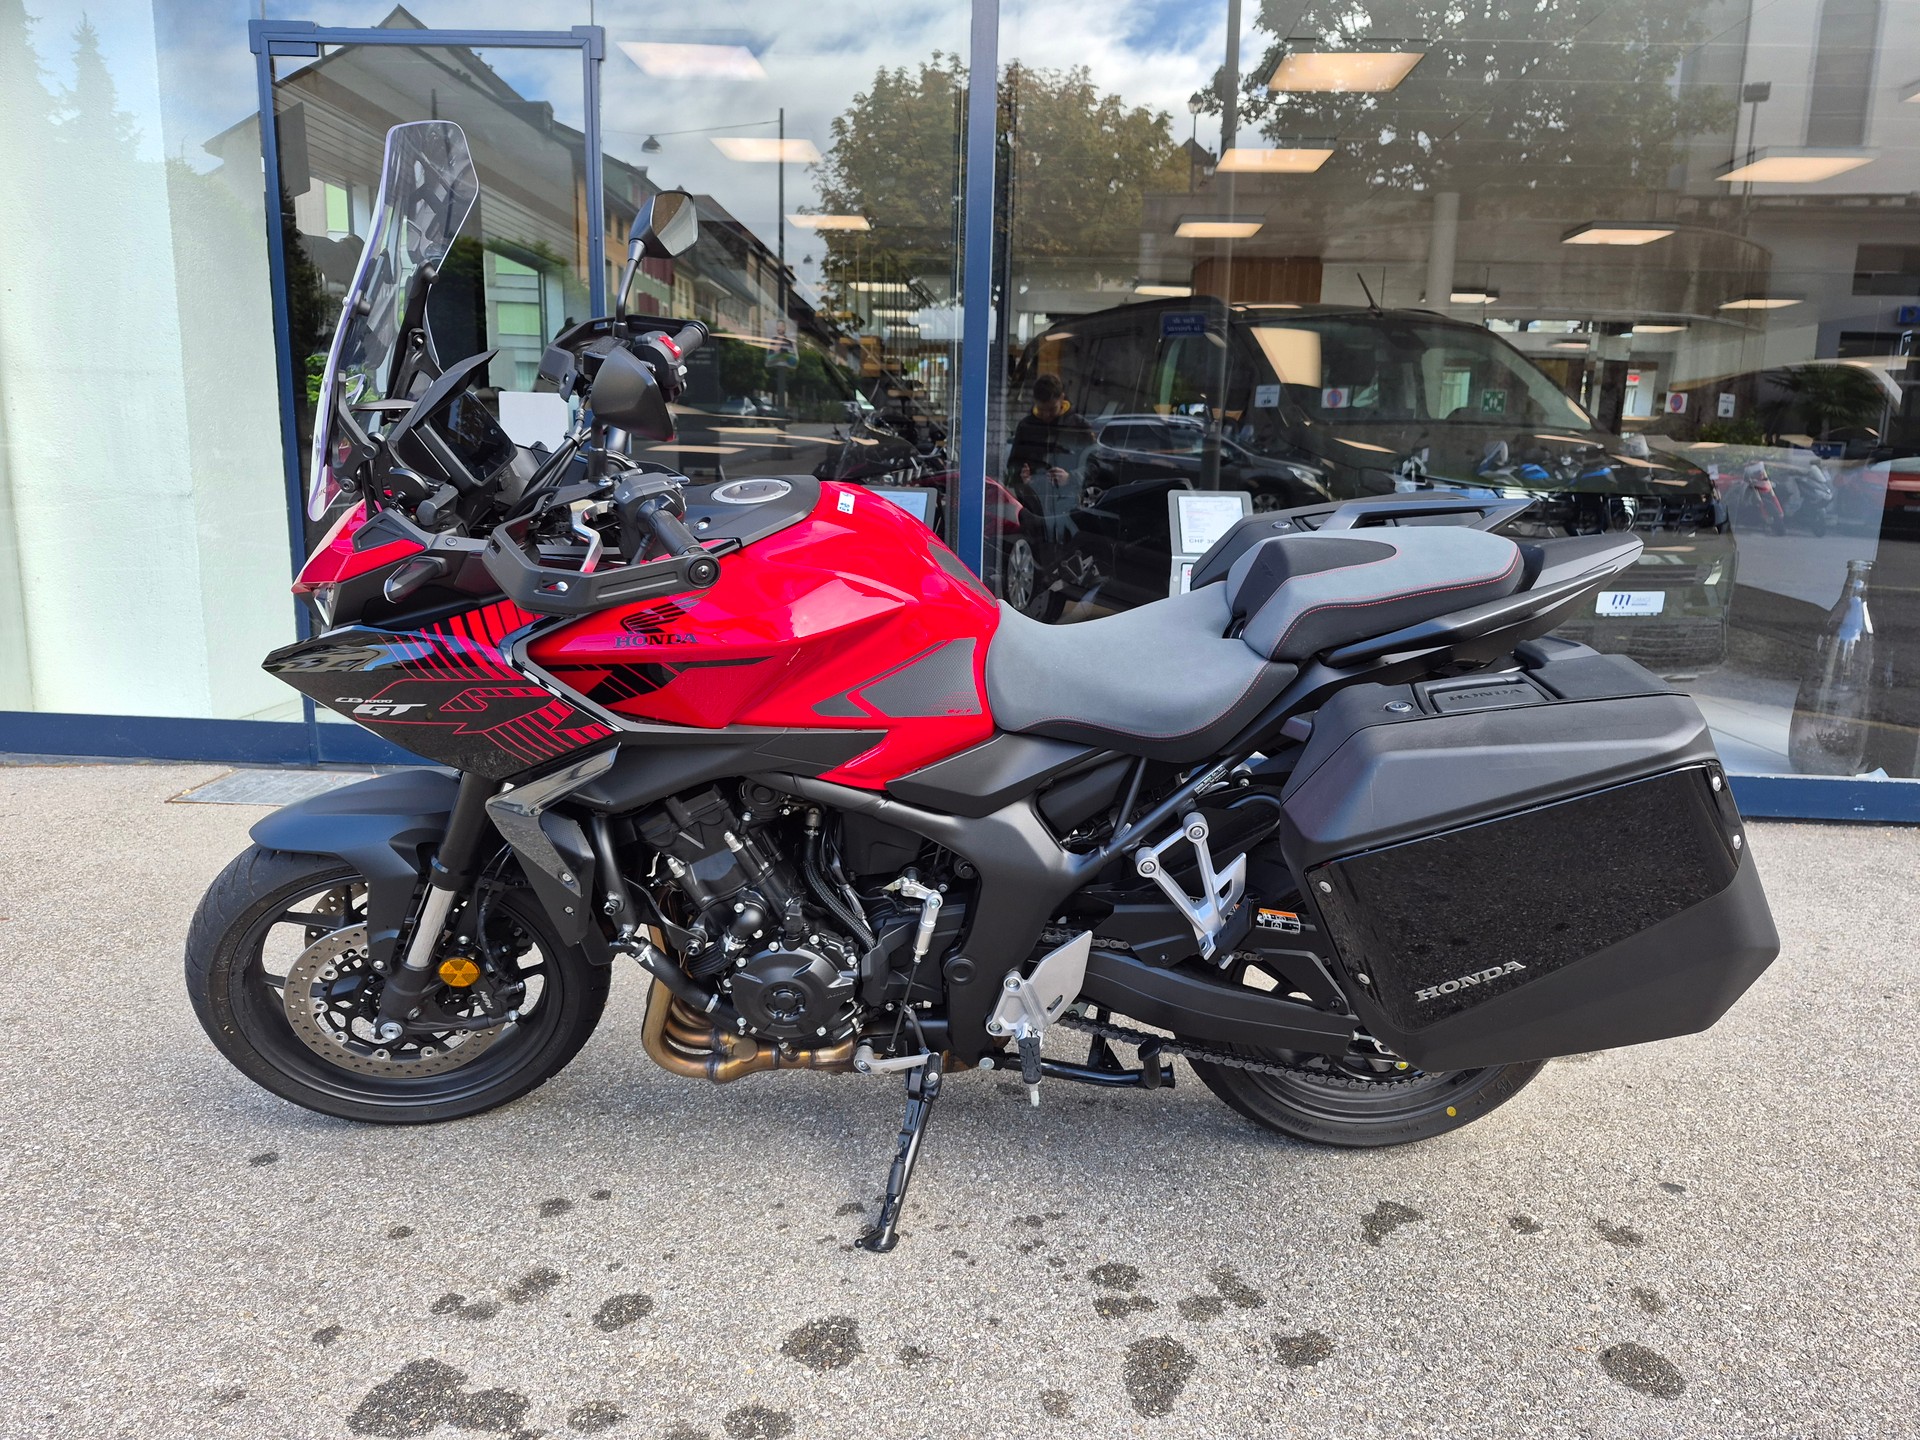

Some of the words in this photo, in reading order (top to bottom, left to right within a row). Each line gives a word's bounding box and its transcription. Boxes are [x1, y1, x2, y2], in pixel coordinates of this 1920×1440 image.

[613, 633, 698, 649] HONDA
[1448, 688, 1525, 702] HONDA
[352, 703, 428, 717] GT
[1414, 960, 1527, 1002] HONDA
